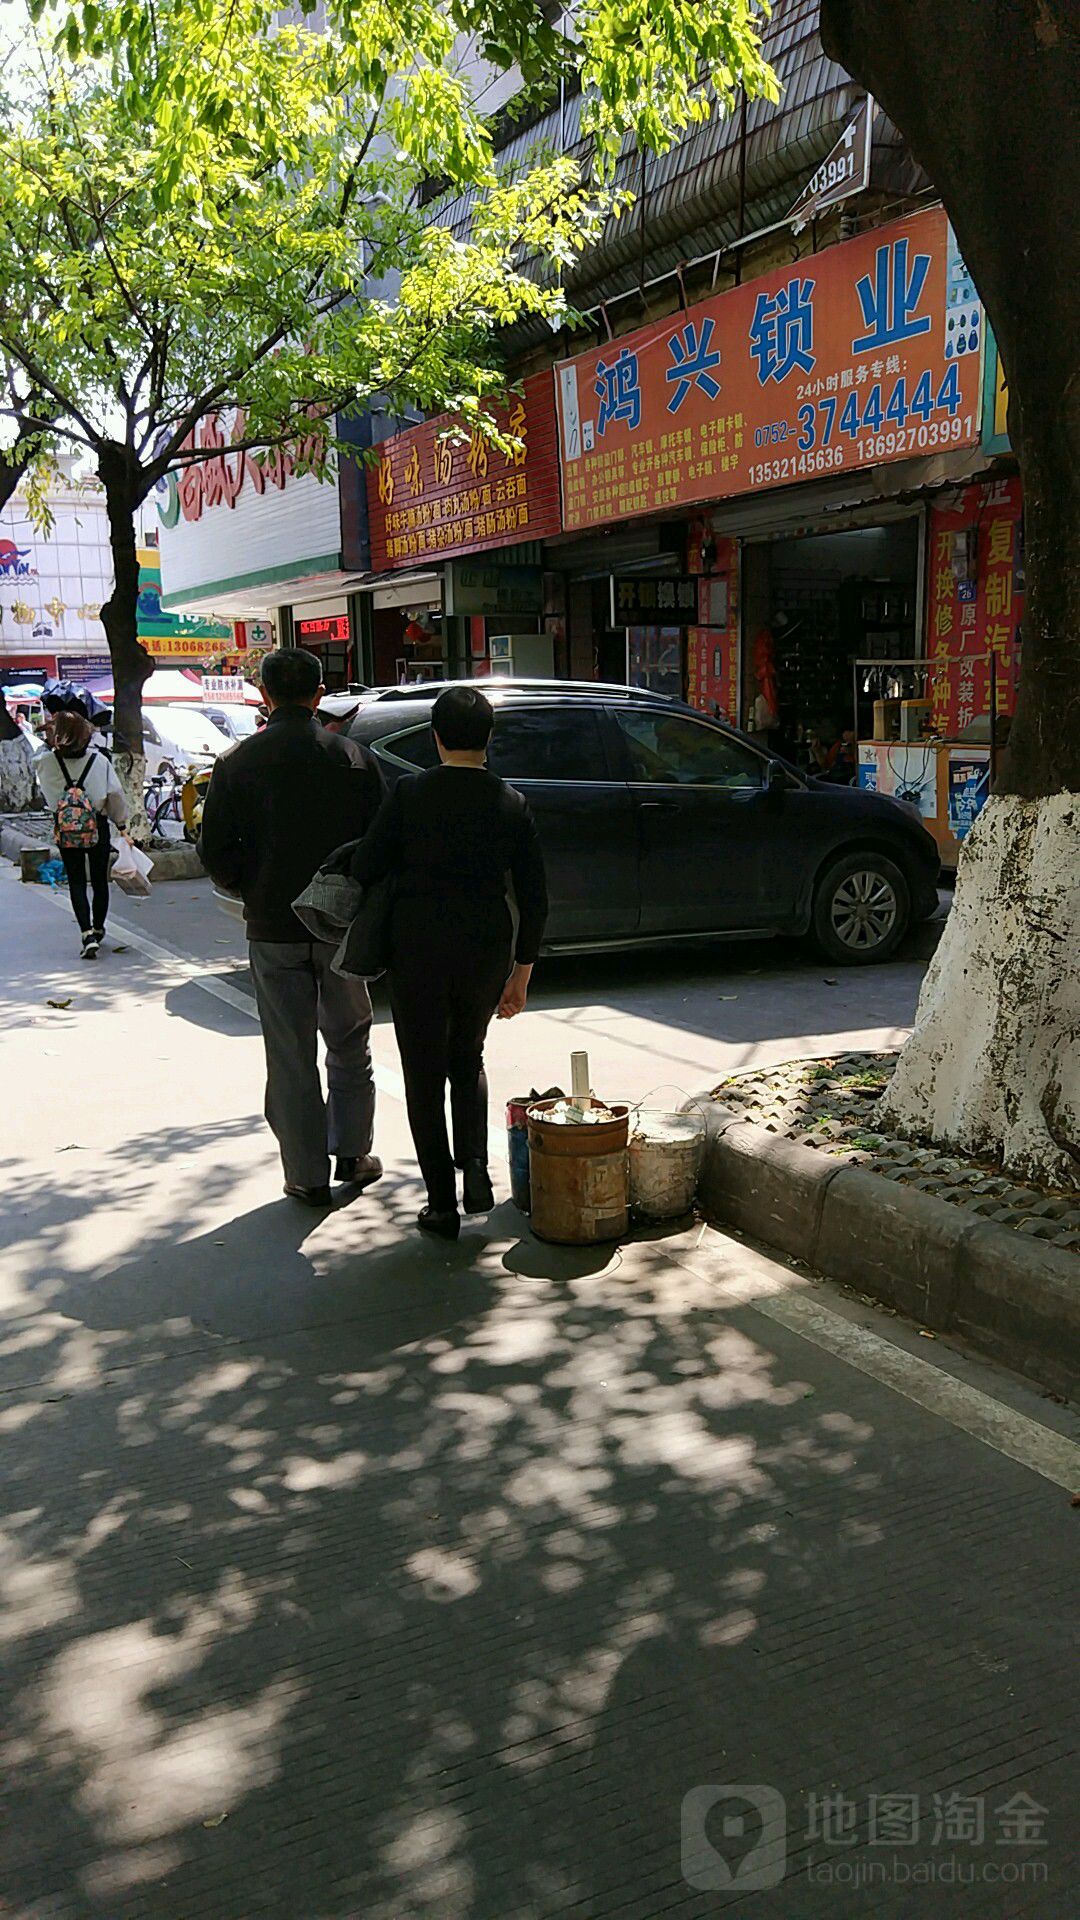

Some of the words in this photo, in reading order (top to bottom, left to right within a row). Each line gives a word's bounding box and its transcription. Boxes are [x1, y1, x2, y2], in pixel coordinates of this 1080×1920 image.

[594, 238, 932, 437] 鸿兴锁业
[755, 362, 962, 451] 0752-3744444
[749, 446, 843, 485] 13532145636
[857, 415, 972, 461] 13692703991
[982, 519, 1014, 711] 复制汽车
